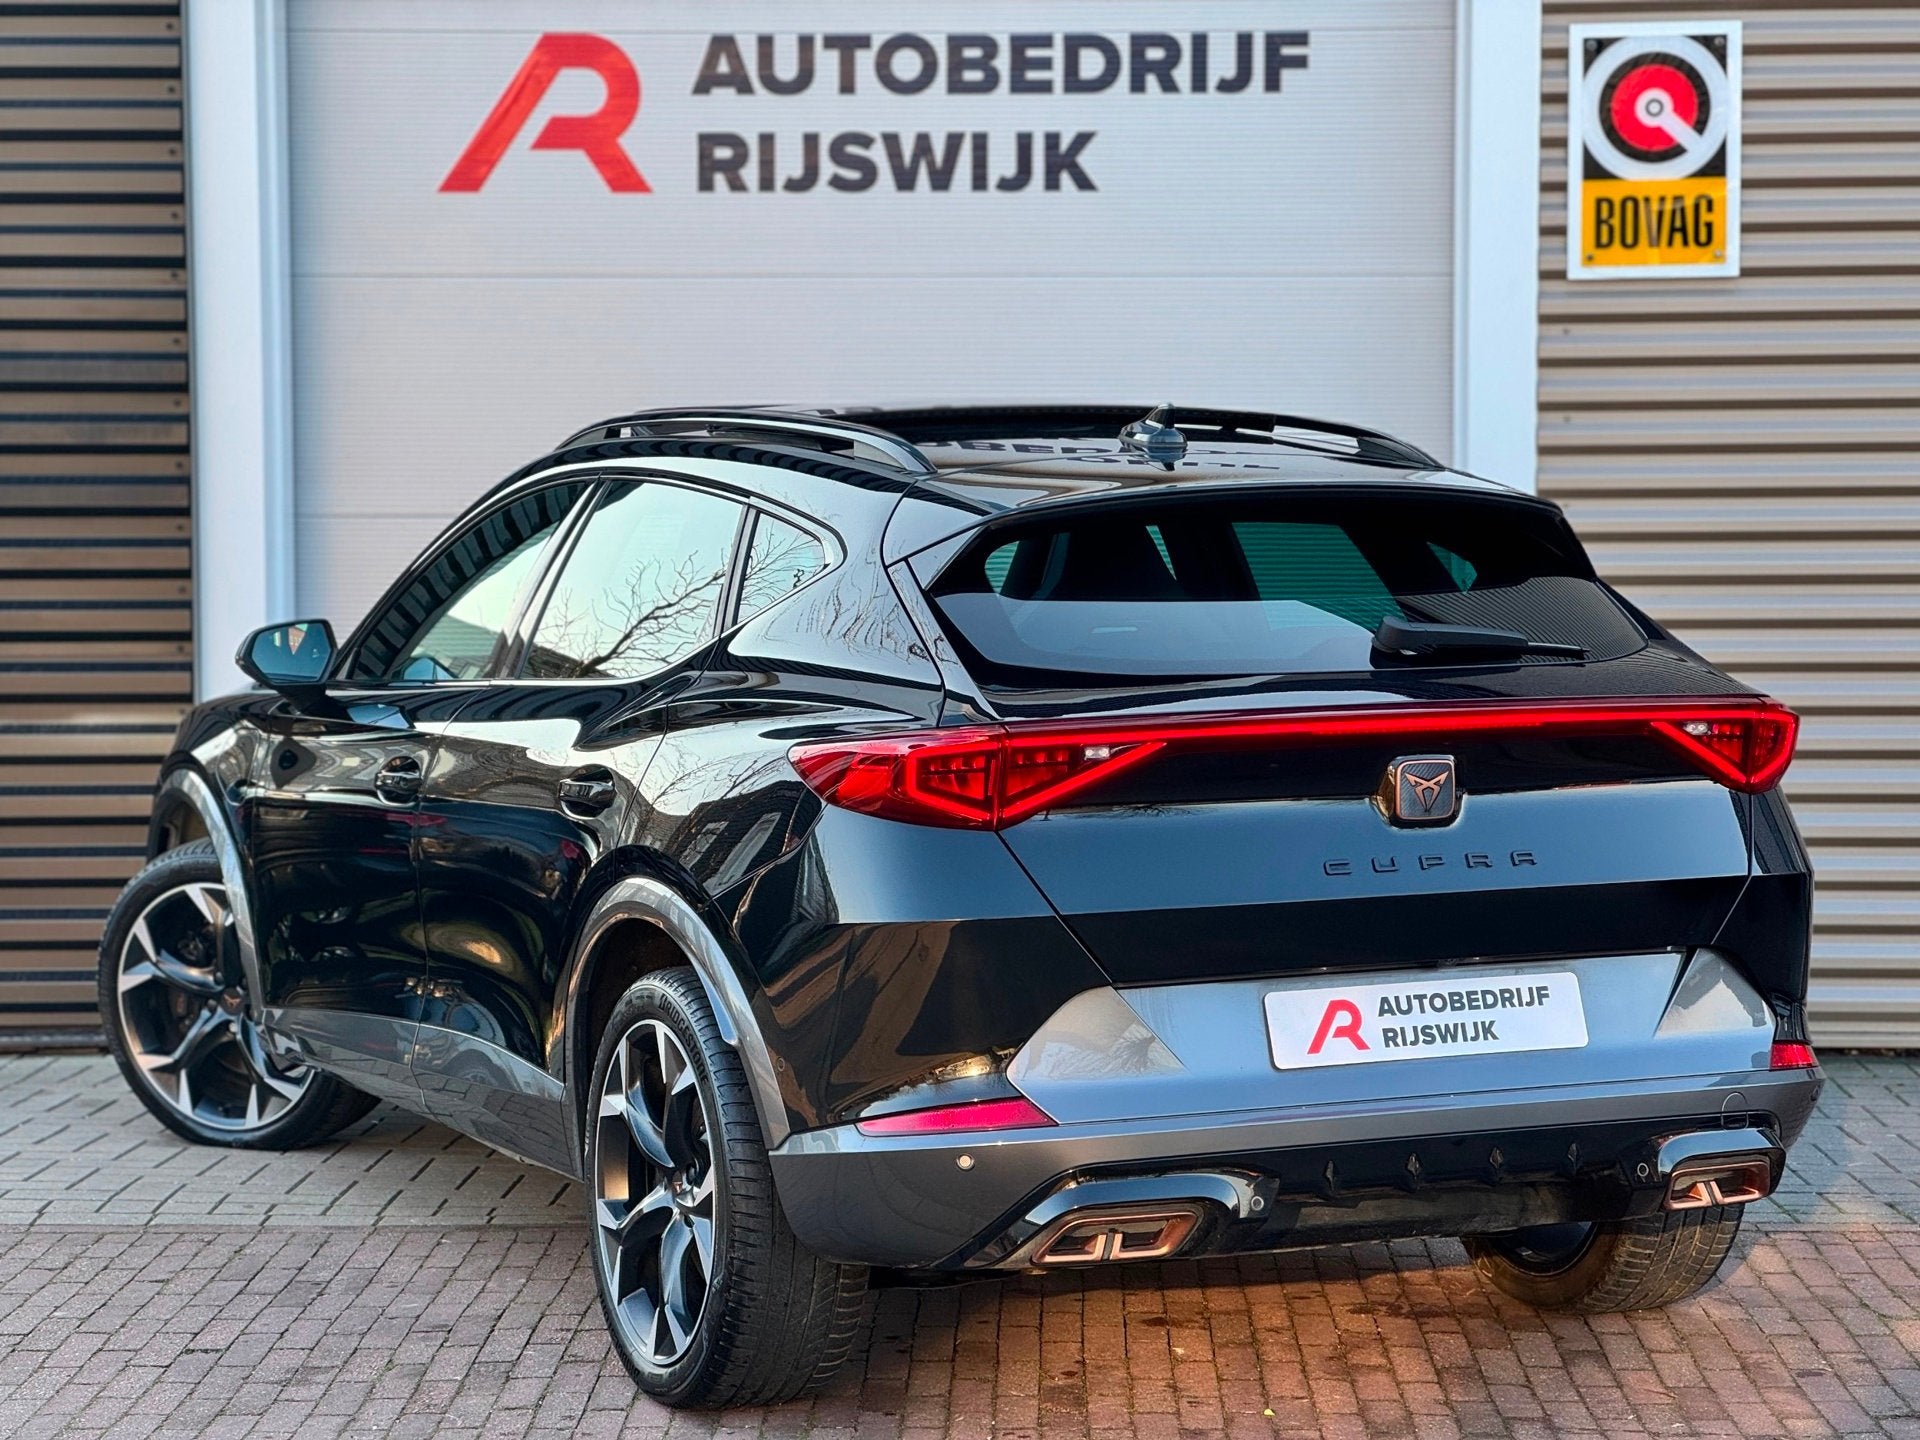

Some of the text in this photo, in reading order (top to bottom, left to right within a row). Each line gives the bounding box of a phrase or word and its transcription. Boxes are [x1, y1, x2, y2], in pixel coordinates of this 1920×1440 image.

[692, 31, 1309, 95] AUTOBEDRIJF
[697, 131, 1099, 192] RIJSWIJK
[1594, 194, 1714, 249] BOVAG
[1323, 850, 1538, 876] CUPRA
[1377, 986, 1550, 1017] AUTOBEDRIJF
[658, 992, 709, 1085] BRIDGESTONE
[1382, 1020, 1499, 1048] RIJSWIJK
